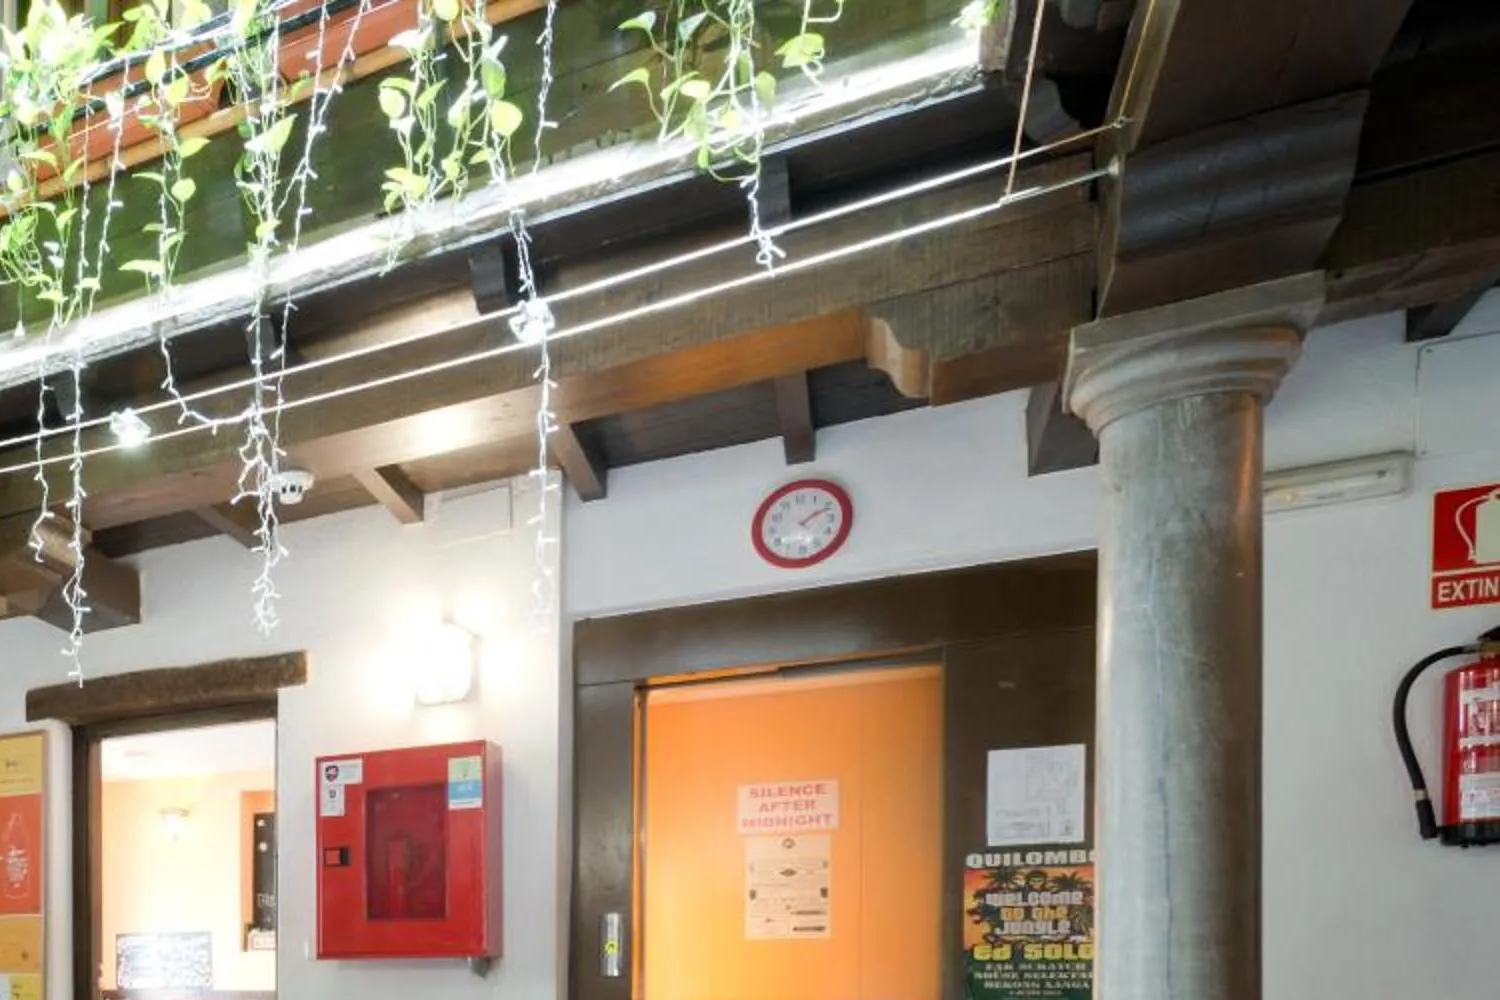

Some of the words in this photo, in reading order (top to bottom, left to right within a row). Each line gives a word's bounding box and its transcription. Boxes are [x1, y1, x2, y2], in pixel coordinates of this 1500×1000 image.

[1438, 576, 1499, 602] EXTIN
[749, 783, 826, 799] SILENCE
[760, 800, 816, 813] AFTER
[741, 813, 834, 828] MIDNIGHT
